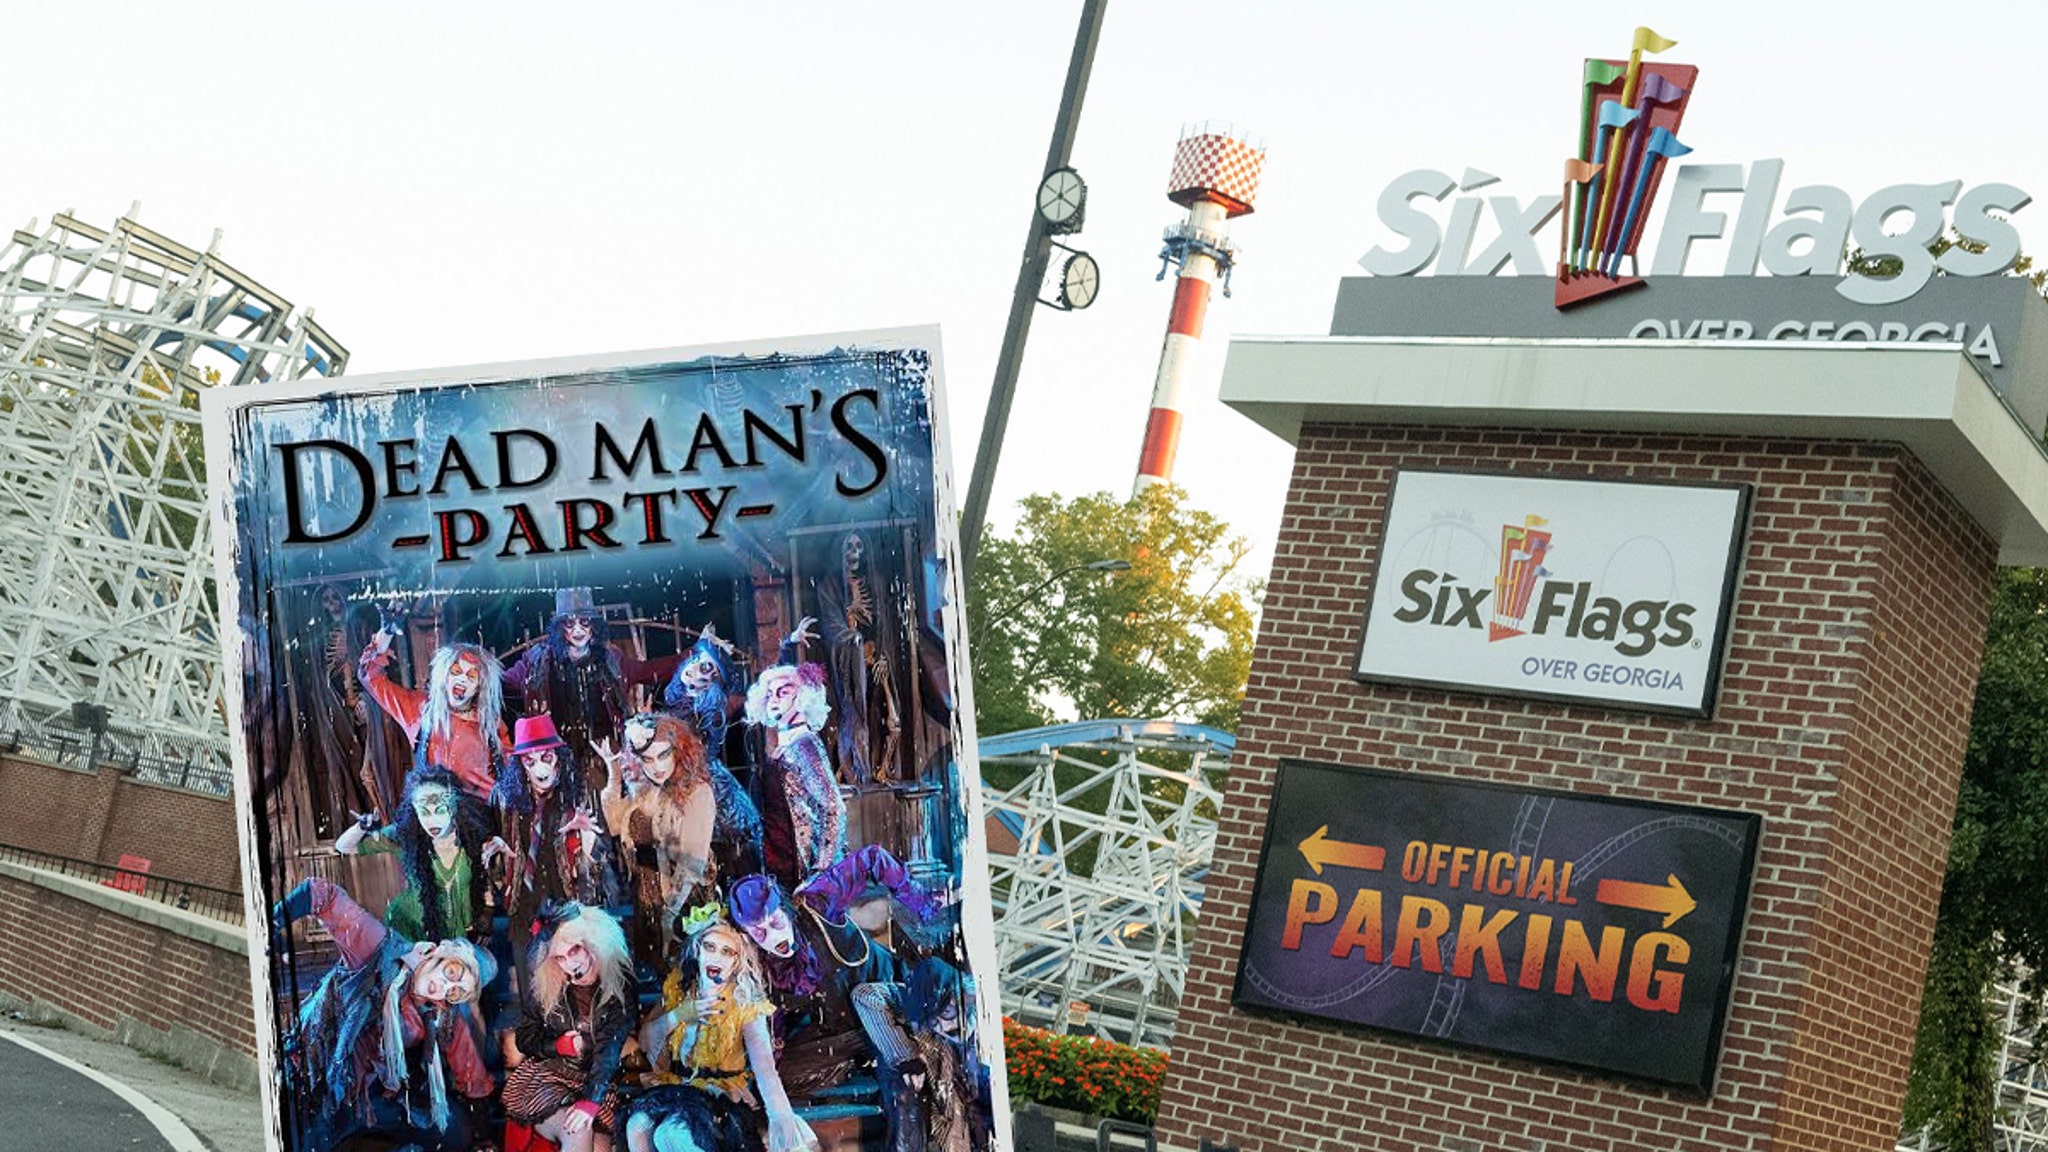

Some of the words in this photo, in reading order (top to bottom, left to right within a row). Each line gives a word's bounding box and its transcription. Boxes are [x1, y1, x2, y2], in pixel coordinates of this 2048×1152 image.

[1357, 166, 1563, 277] Six
[1650, 158, 2034, 305] Flags
[271, 427, 559, 547] DEAD
[589, 388, 889, 498] MAN'S
[1393, 569, 1492, 629] Six
[1521, 656, 1577, 681] OVER
[1583, 663, 1684, 691] GEORGIA
[1402, 839, 1578, 906] OFFICIAL
[1280, 878, 1692, 1015] PARKING
